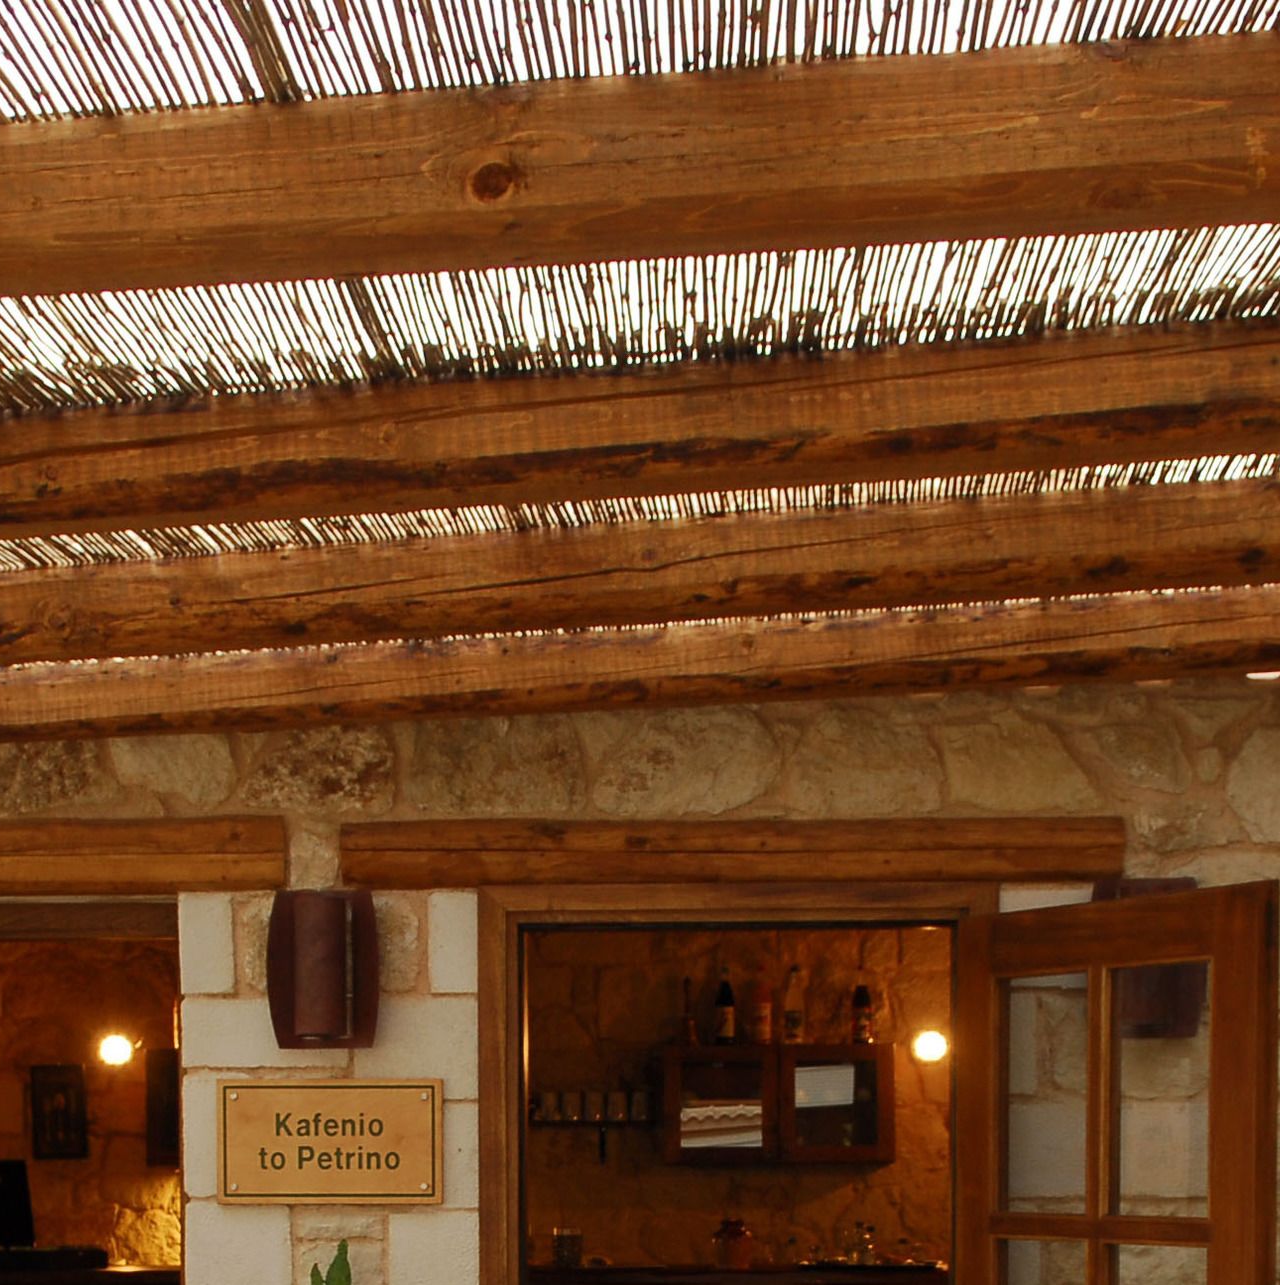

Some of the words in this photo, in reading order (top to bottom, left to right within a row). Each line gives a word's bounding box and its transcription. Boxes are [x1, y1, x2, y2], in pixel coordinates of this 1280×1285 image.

[274, 1112, 385, 1138] Kafenio
[258, 1146, 286, 1171] to
[297, 1145, 401, 1171] Petrino
